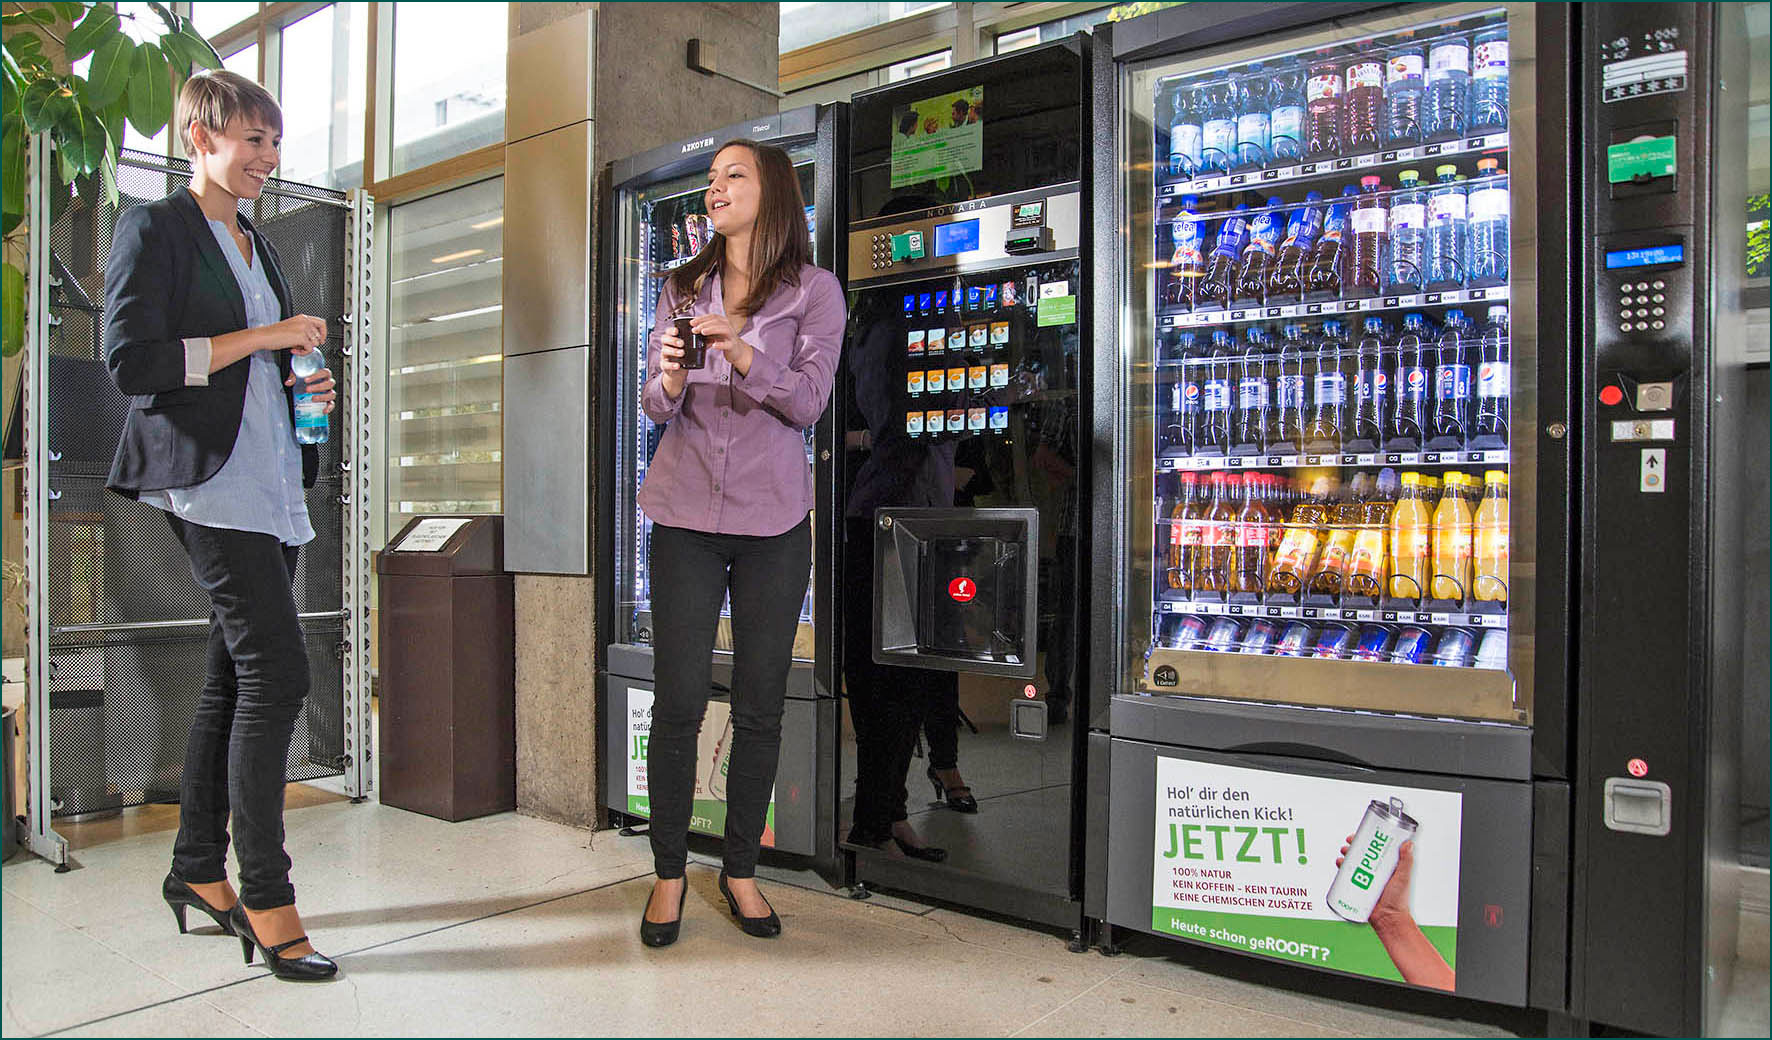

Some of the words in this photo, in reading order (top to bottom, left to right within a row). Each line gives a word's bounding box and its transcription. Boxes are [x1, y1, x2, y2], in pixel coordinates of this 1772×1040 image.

[681, 137, 714, 153] AZKOYEN
[928, 201, 986, 217] NOVARA
[1199, 787, 1218, 800] dir
[1222, 787, 1250, 801] den
[1168, 805, 1250, 820] natürlichen
[1254, 807, 1294, 821] Kick!
[1163, 823, 1308, 865] JETZT!
[1360, 829, 1388, 870] PURE
[1172, 867, 1198, 877] 100%
[1200, 869, 1232, 879] NATUR
[1172, 880, 1193, 889] KEIN
[1195, 881, 1234, 892] KOFFEIN
[1244, 885, 1267, 895] KEIN
[1270, 886, 1307, 896] TAURIN
[1173, 893, 1199, 903] KEINE
[1201, 894, 1265, 907] CHEMISCHEN
[1267, 898, 1313, 911] ZUSÄTZE
[1171, 917, 1206, 936] Heute
[1209, 928, 1246, 945] schon
[1249, 936, 1330, 961] geROOFT?
